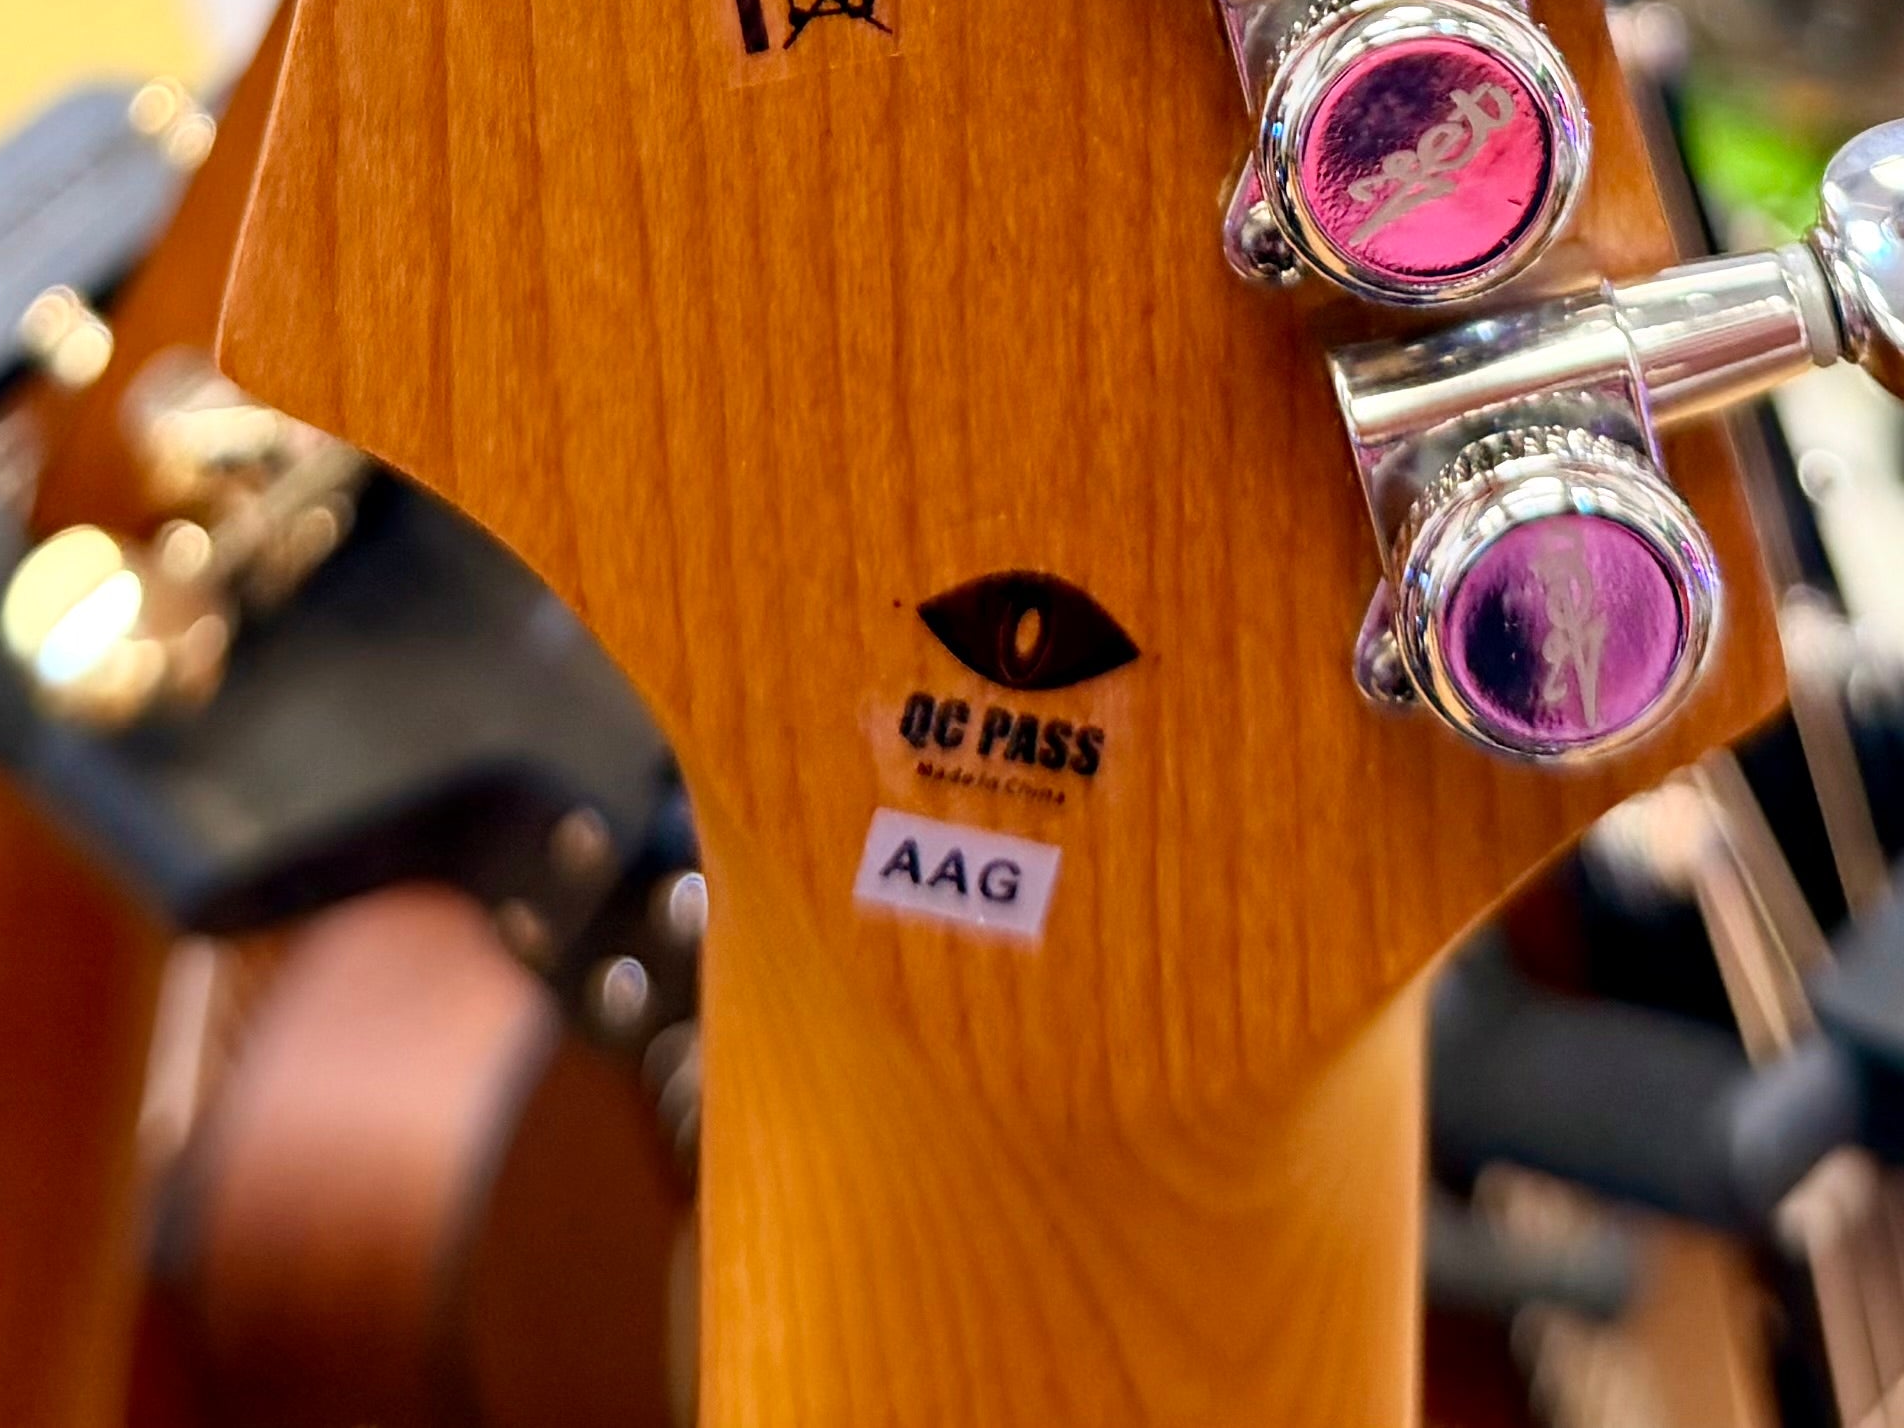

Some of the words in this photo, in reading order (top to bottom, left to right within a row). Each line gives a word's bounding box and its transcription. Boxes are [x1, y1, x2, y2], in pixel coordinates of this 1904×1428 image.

[899, 691, 971, 750] QC
[977, 706, 1106, 776] PASS
[916, 760, 975, 786] Made
[1004, 775, 1066, 806] China
[879, 836, 1022, 904] AAG
